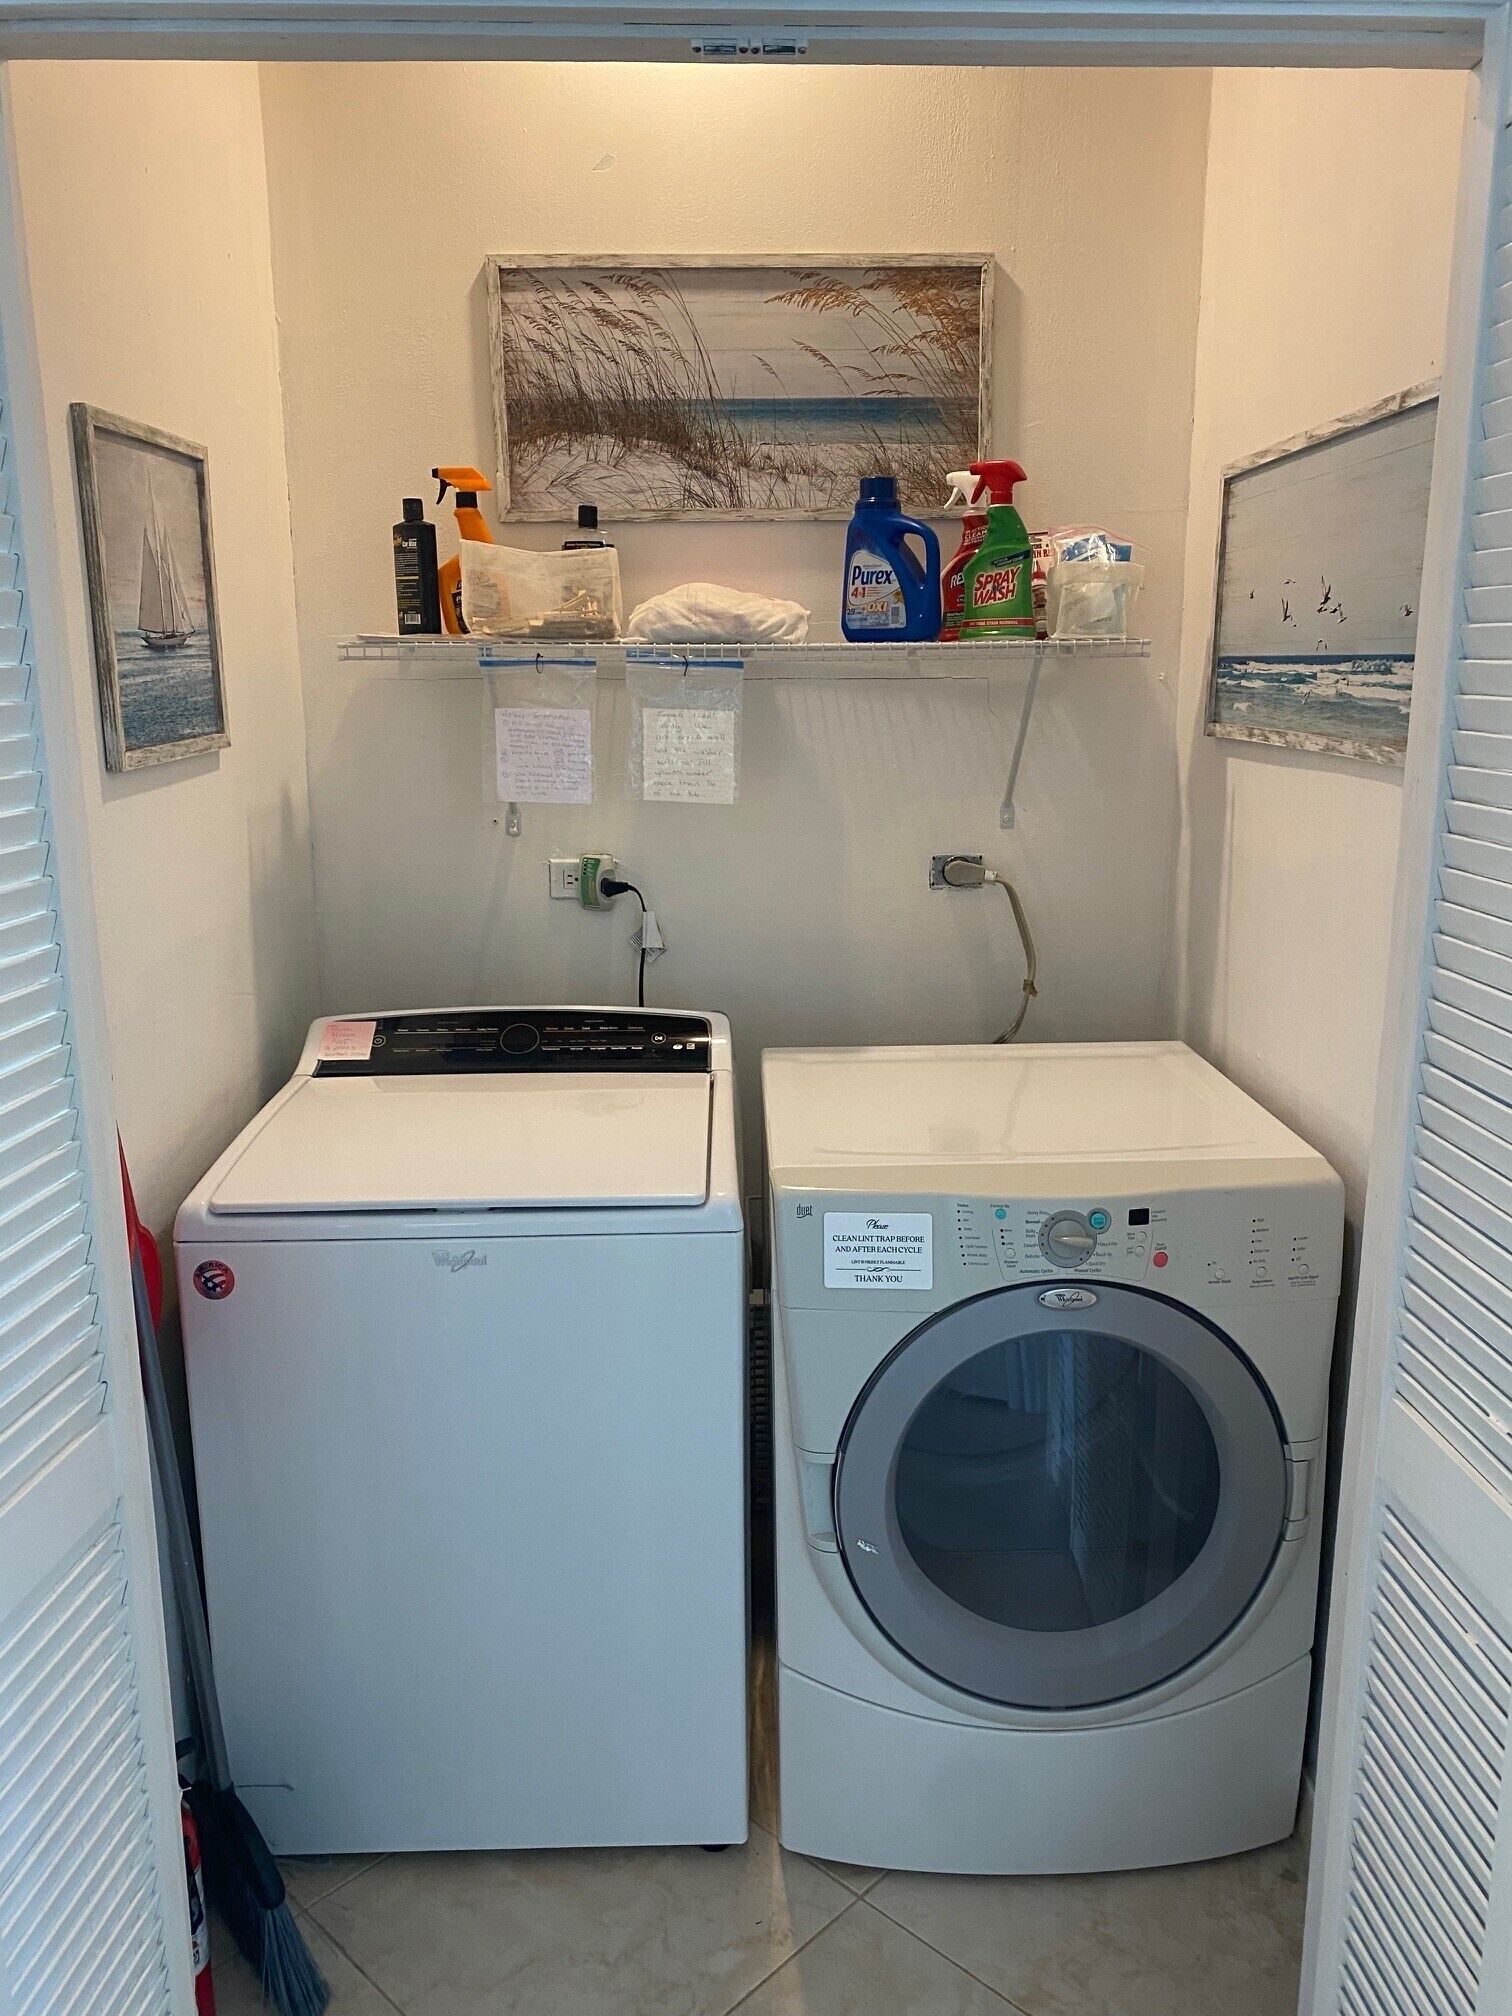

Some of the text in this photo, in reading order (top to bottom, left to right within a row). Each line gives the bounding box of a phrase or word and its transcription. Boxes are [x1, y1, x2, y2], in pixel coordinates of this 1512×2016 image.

[851, 566, 894, 586] Purex
[975, 566, 1021, 592] SPRAY
[974, 582, 1016, 606] WASH
[796, 1203, 814, 1219] duet
[865, 1219, 890, 1230] Please
[832, 1234, 857, 1242] CLEAN
[874, 1235, 896, 1243] TRAP
[896, 1235, 925, 1243] BEFORE
[898, 1246, 923, 1254] CYCLE
[855, 1274, 903, 1283] THANK YOU
